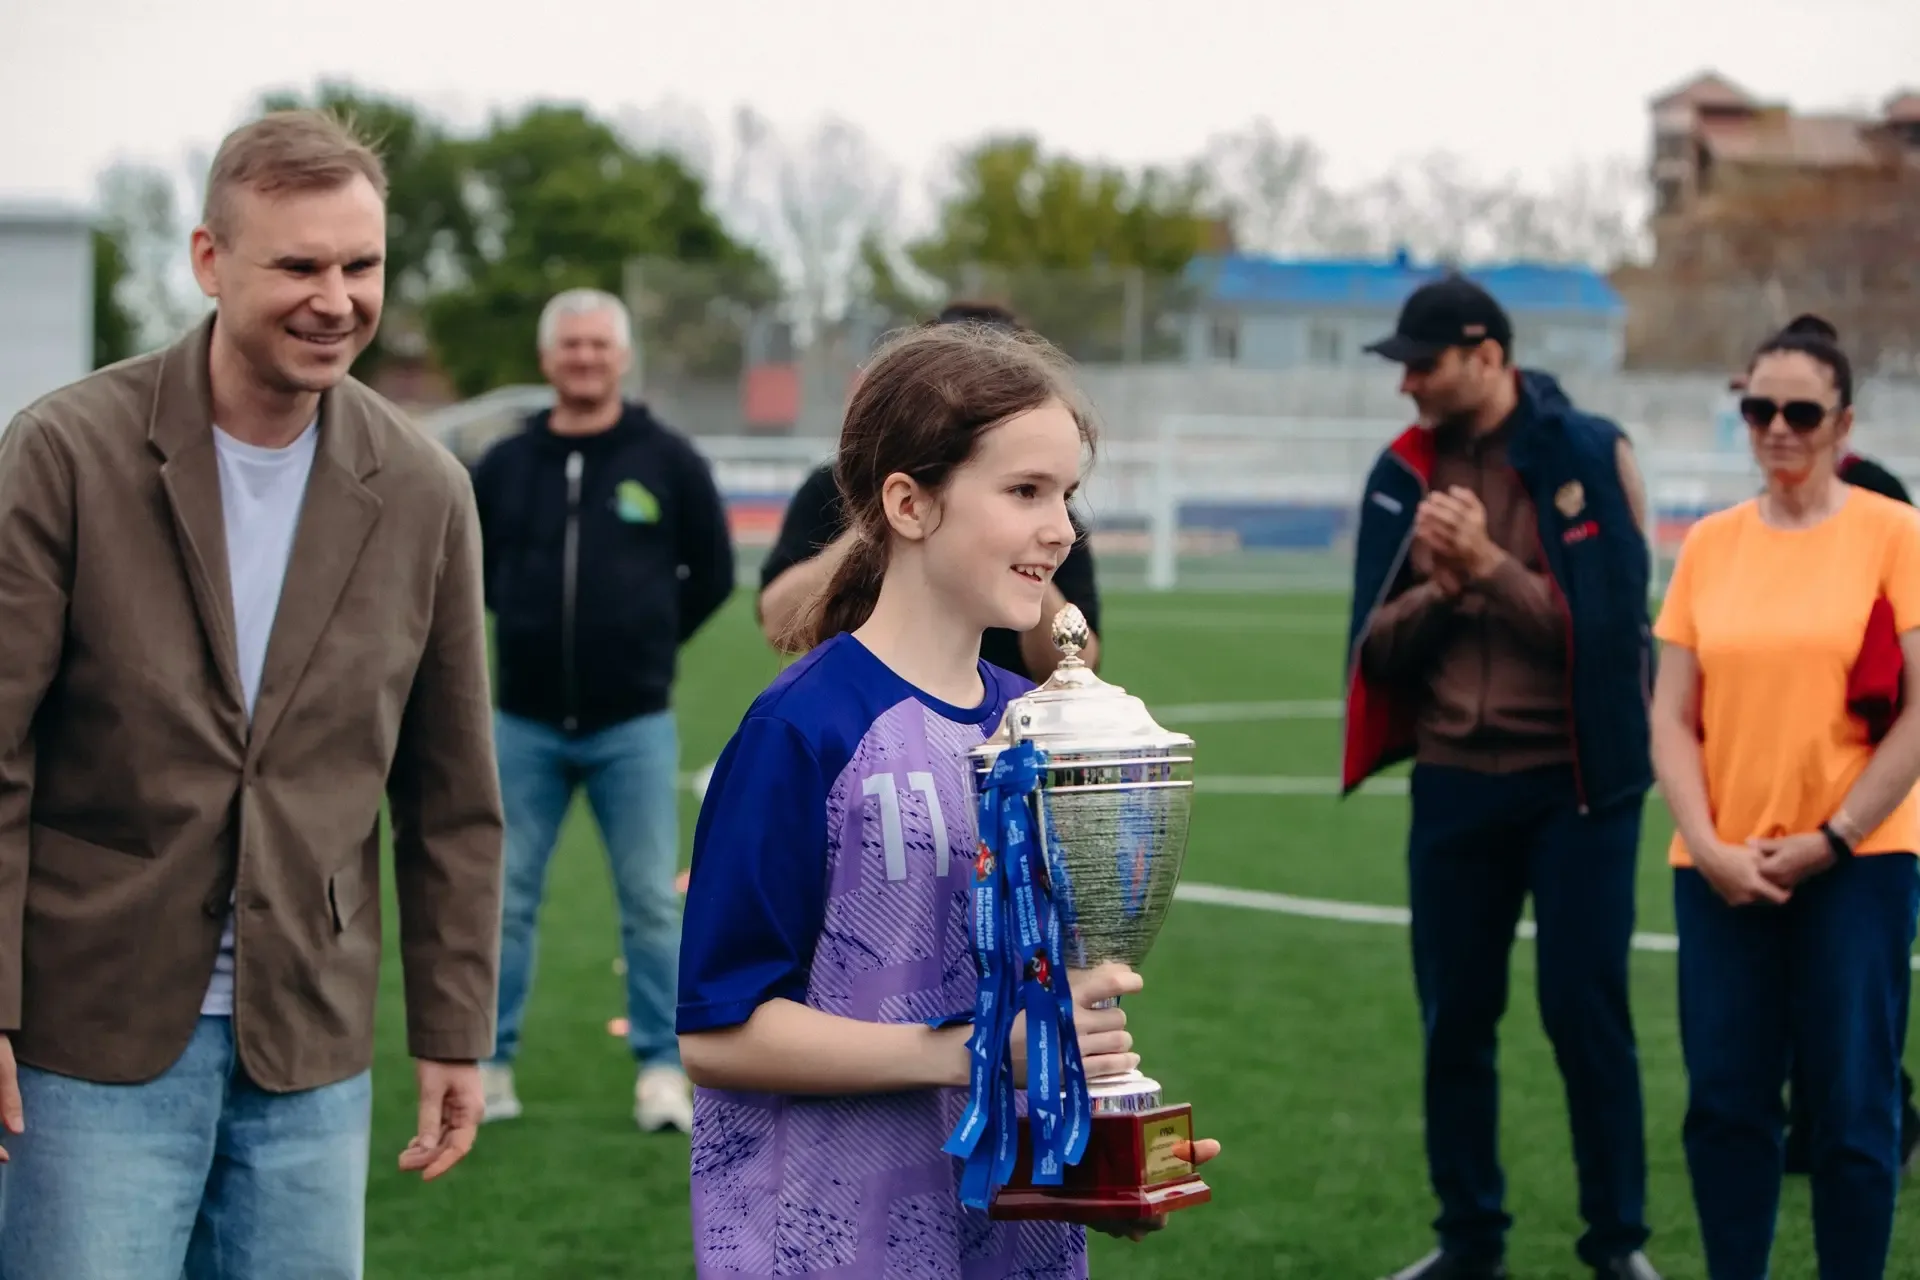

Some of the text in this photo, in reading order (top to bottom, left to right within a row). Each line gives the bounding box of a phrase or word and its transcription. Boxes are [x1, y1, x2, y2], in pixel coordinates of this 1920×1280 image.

[862, 771, 950, 881] 11
[976, 887, 991, 979] ШКОЛЬНАЯ ЛИГА
[985, 887, 994, 951] РЕГБИЙНАЯ
[1016, 887, 1031, 947] РЕГБИЙНАЯ
[1020, 854, 1042, 944] ШКОЛЬНАЯ ЛИГА
